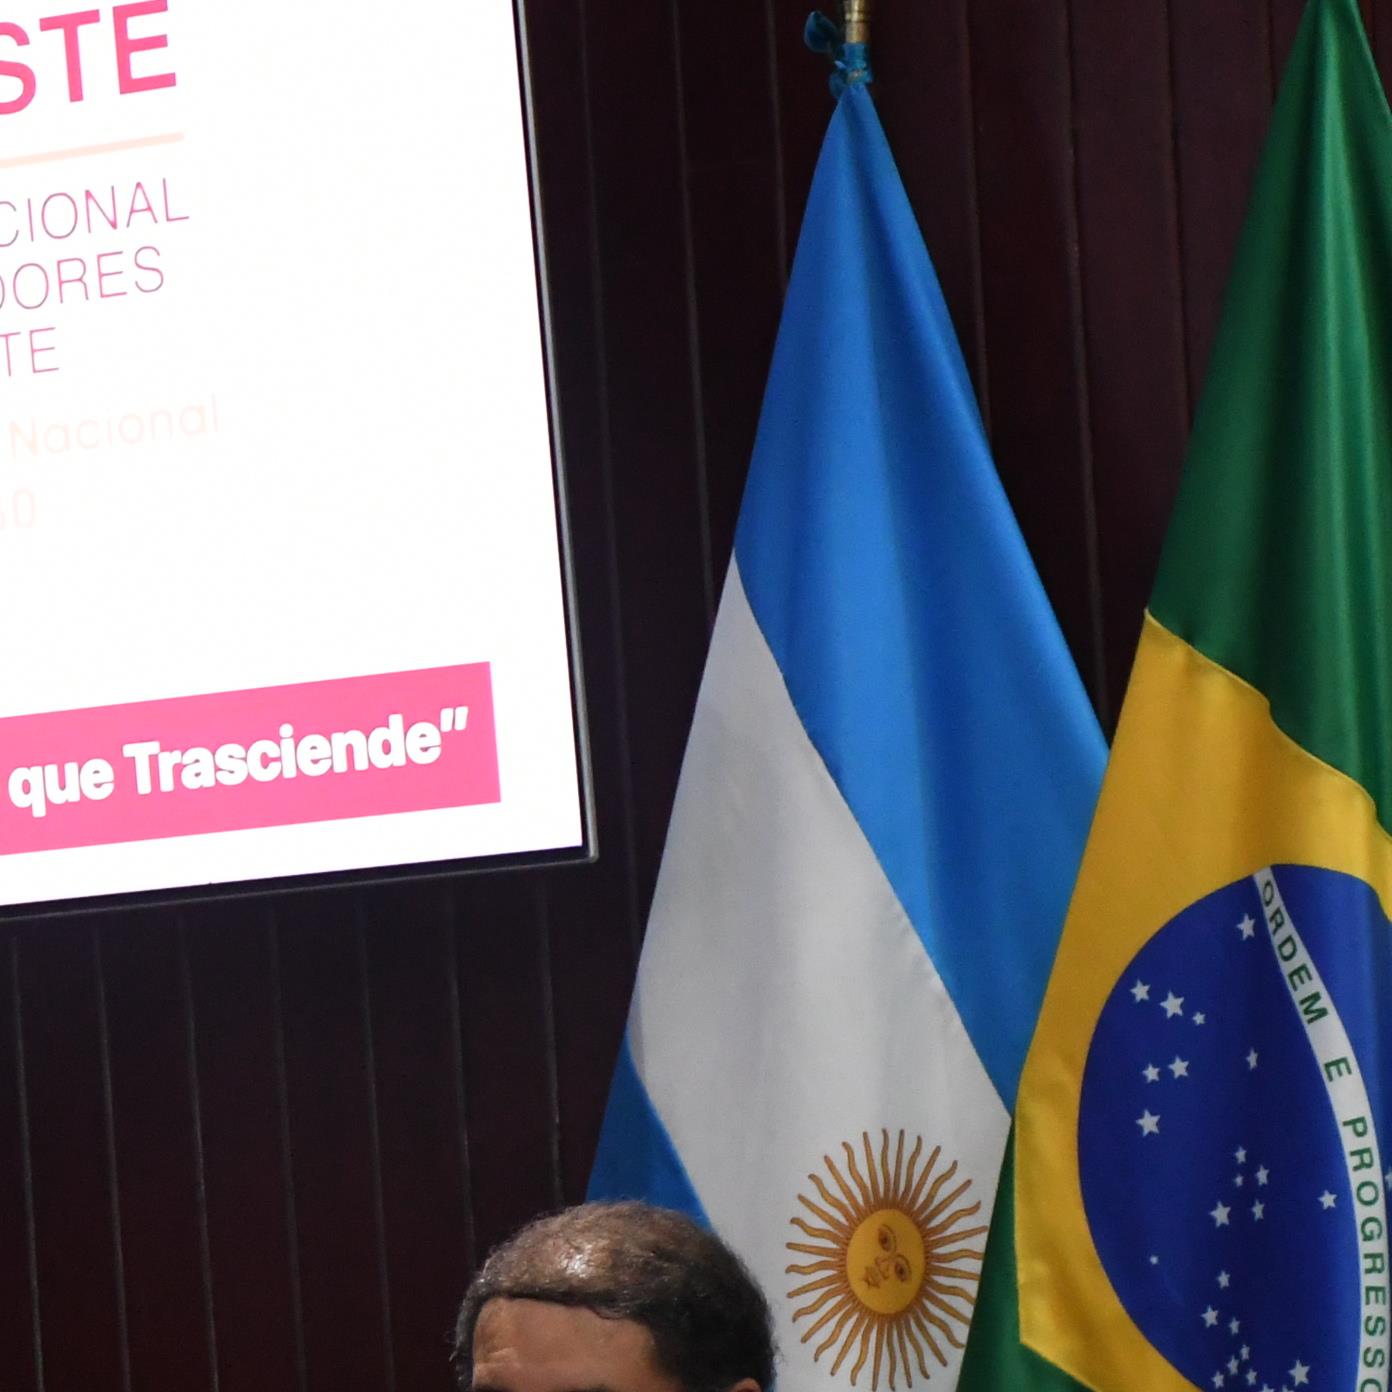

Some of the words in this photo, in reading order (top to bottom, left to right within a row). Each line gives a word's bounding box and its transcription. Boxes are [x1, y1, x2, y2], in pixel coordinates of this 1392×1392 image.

[10, 393, 219, 460] Nacional
[7, 766, 114, 818] que
[123, 706, 469, 797] Trasciende”
[1260, 879, 1328, 1025] ORDEM
[1325, 1055, 1353, 1083] E
